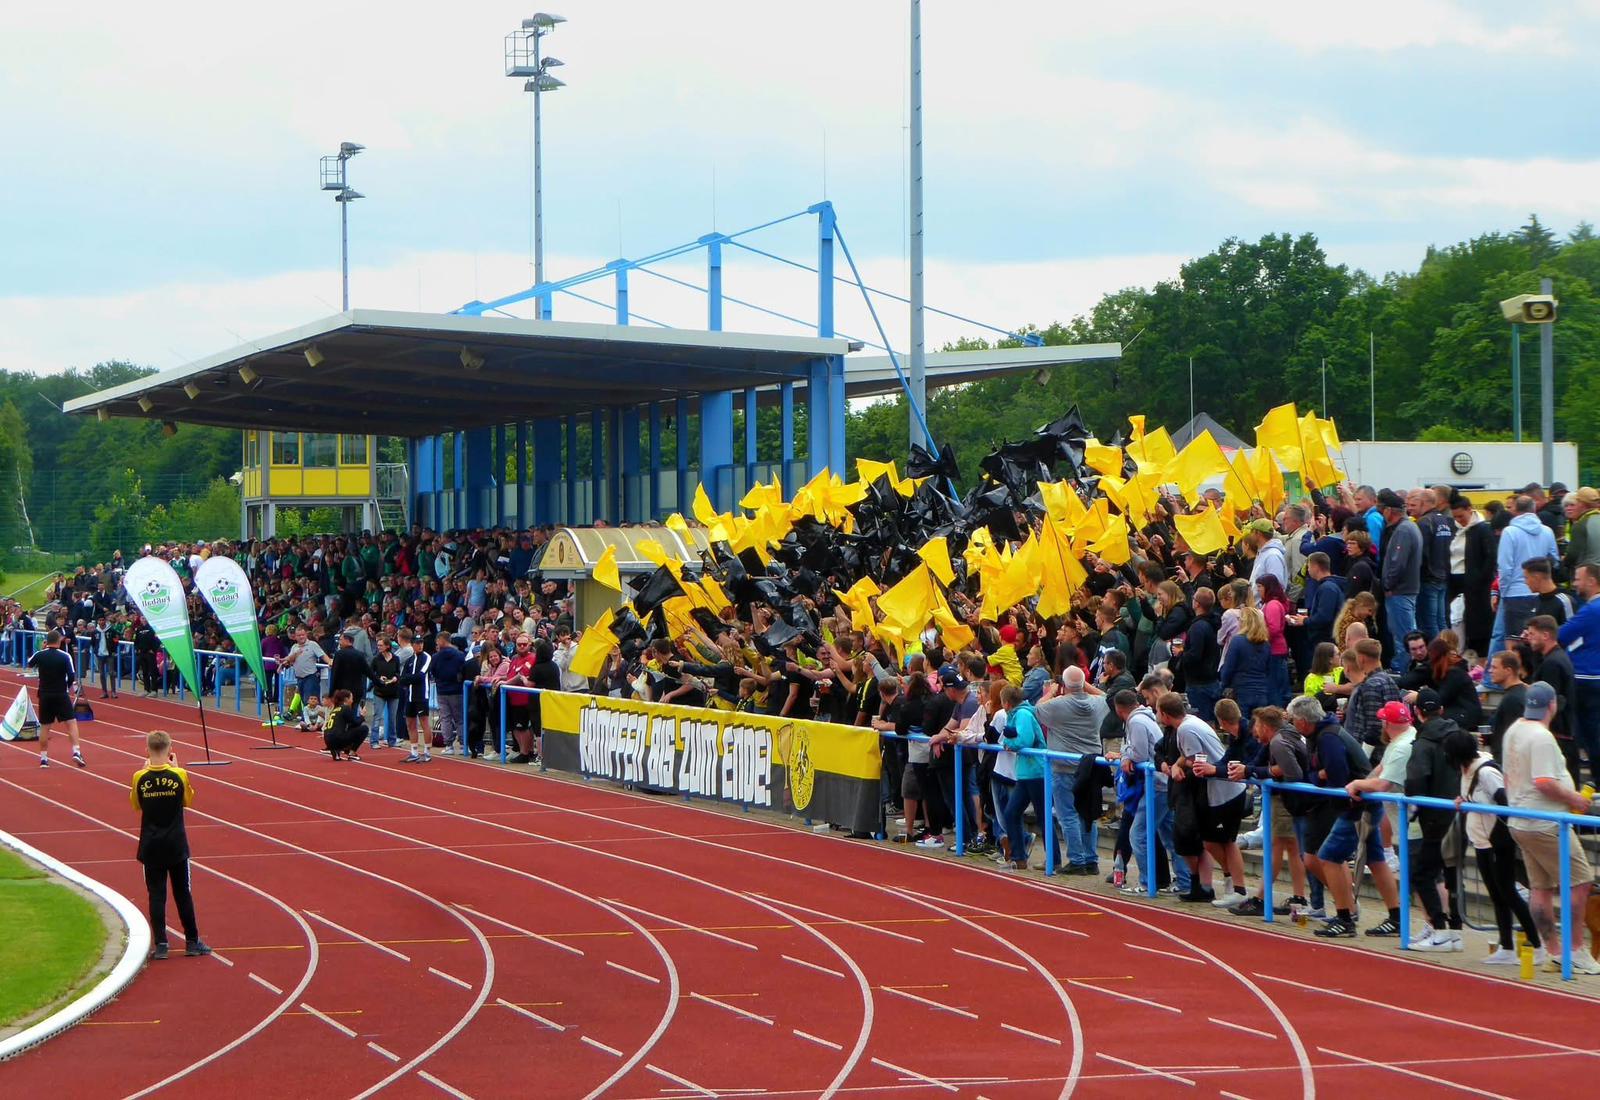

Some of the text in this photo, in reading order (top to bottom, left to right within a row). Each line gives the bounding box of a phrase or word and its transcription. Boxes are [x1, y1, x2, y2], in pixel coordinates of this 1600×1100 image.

[140, 777, 179, 792] SC 1999
[649, 716, 675, 788] BIS
[678, 718, 718, 796] ZUM
[722, 724, 772, 806] ENDE!
